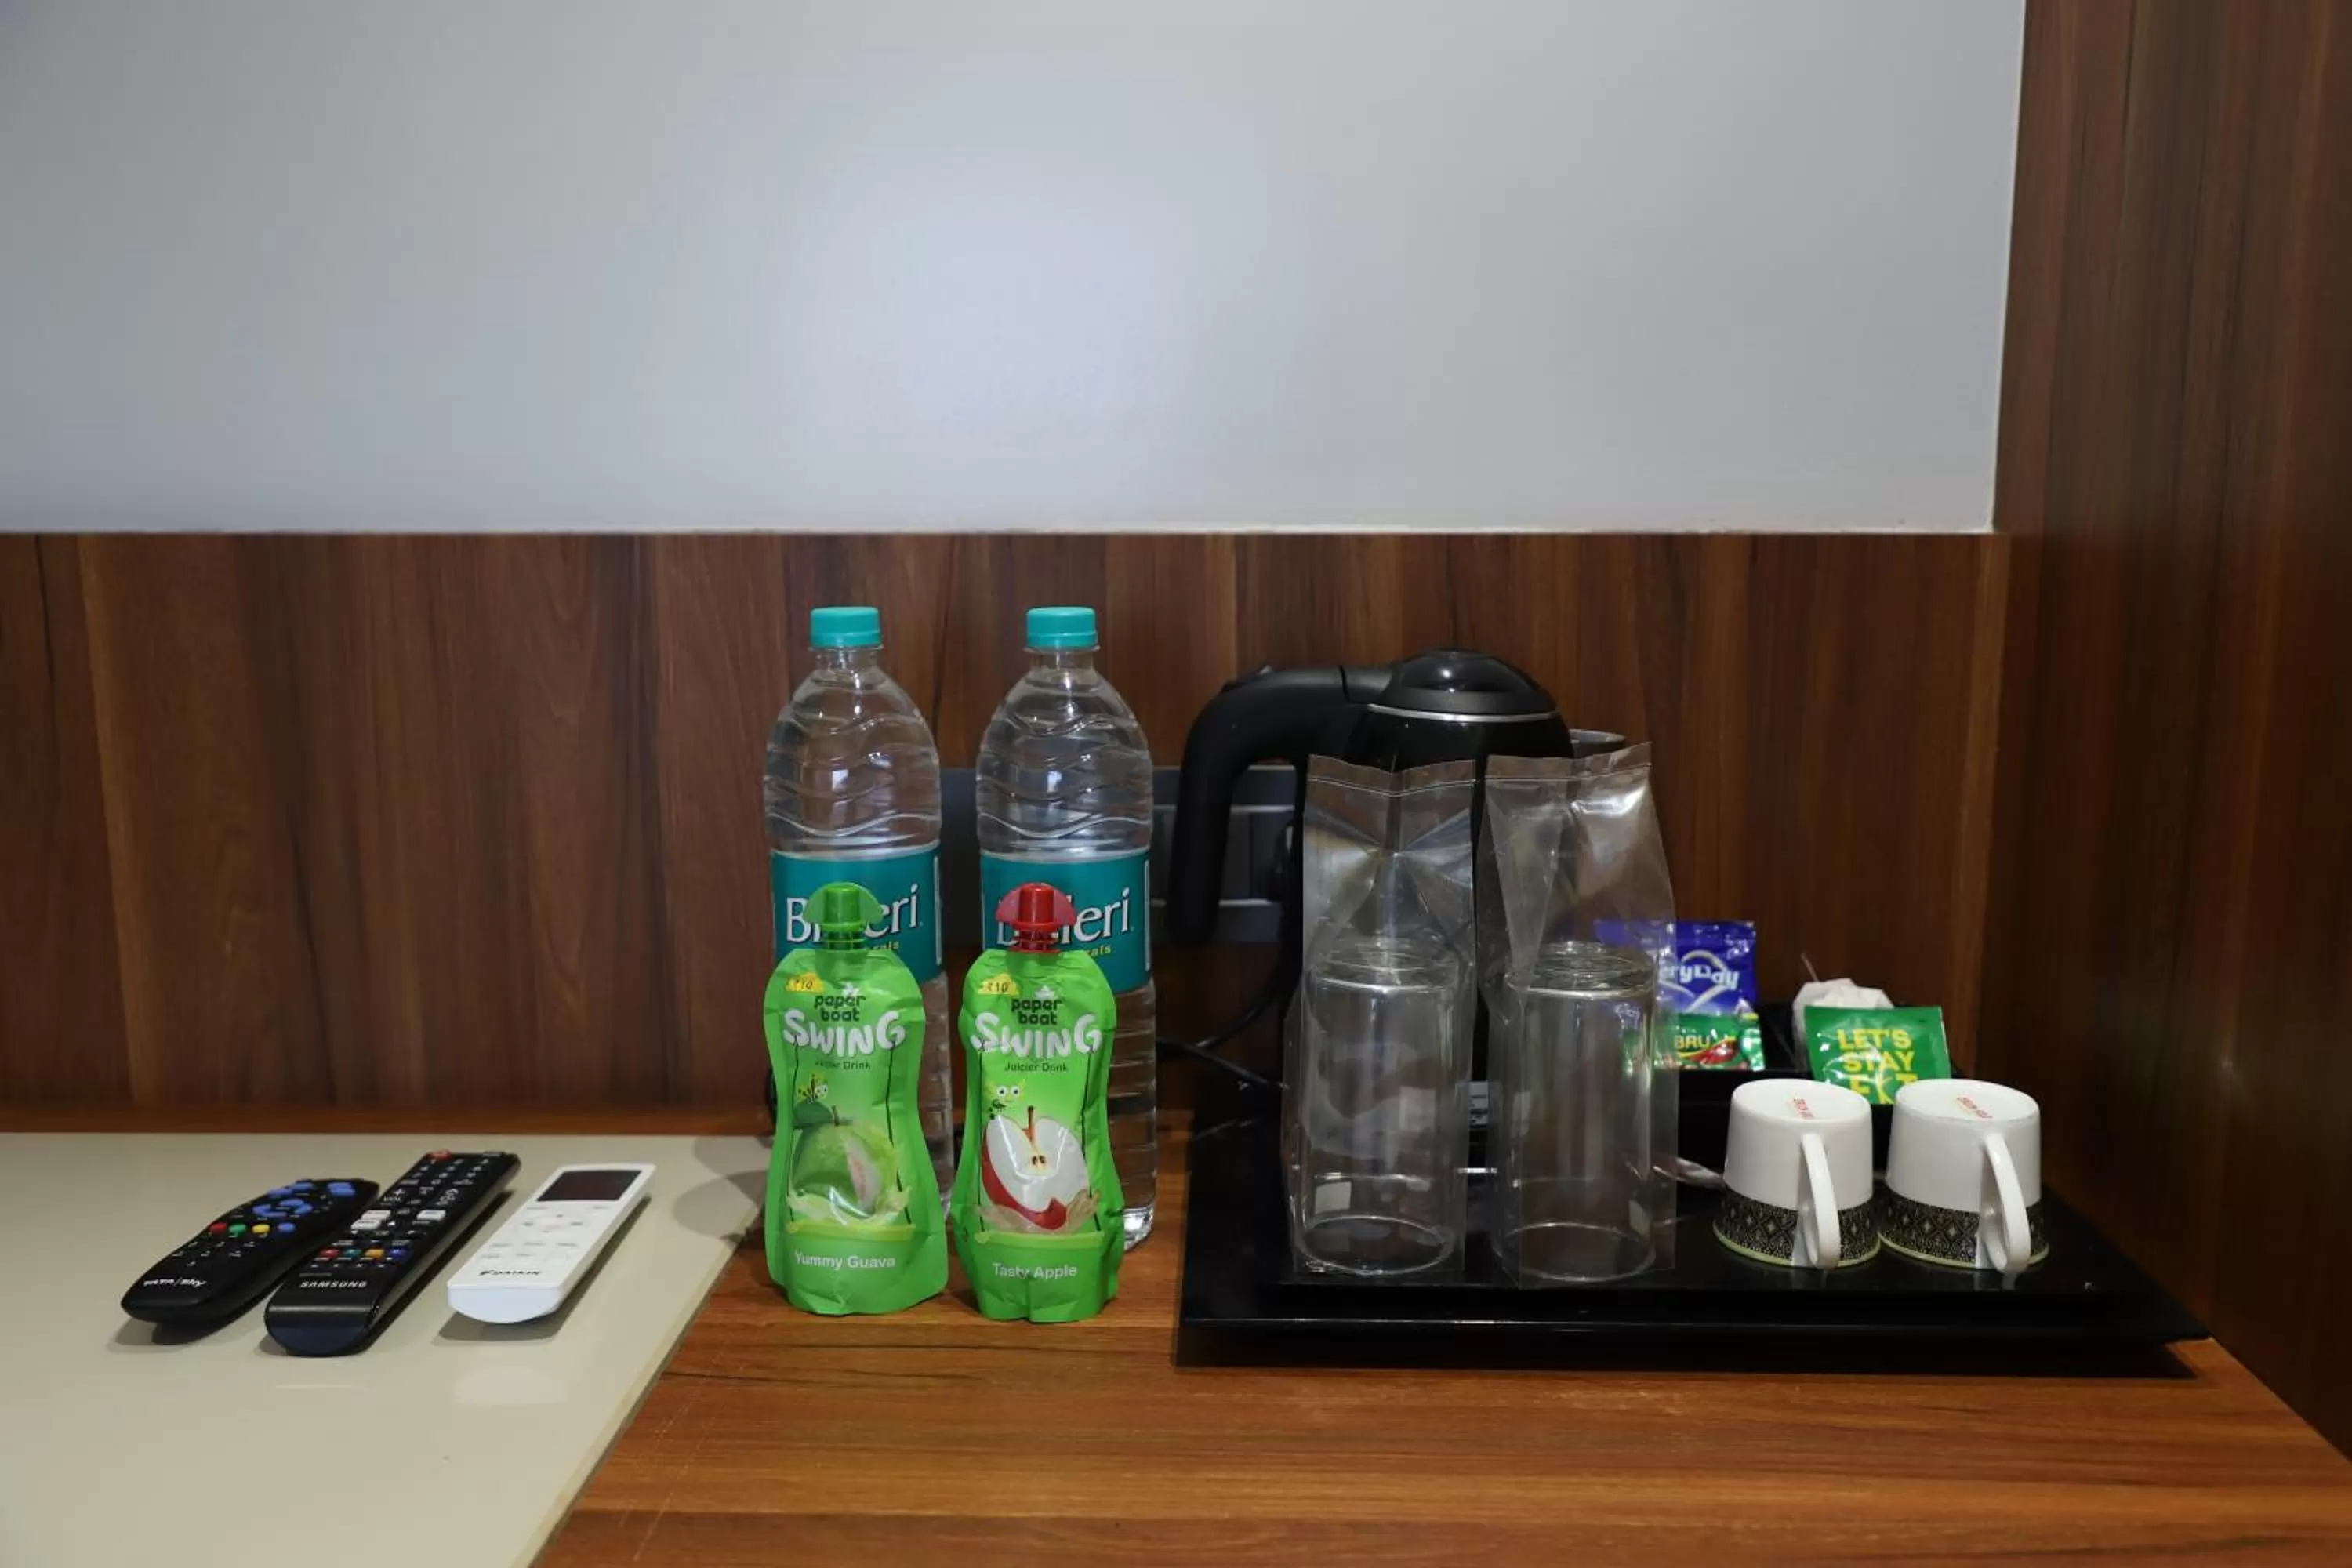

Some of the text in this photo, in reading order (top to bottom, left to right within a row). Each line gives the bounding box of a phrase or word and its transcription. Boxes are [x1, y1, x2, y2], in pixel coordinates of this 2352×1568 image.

[815, 995, 866, 1009] paper
[1011, 999, 1062, 1012] paper
[820, 1007, 860, 1022] boat
[1018, 1011, 1058, 1025] boat
[782, 1008, 906, 1058] SWING
[970, 1011, 1102, 1058] SWING
[1675, 1035, 1711, 1048] BRU
[1837, 1029, 1911, 1049] LET'S
[1842, 1051, 1915, 1072] STAY
[794, 1250, 896, 1270] Yummy Guava
[992, 1262, 1076, 1280] Tasty Apple
